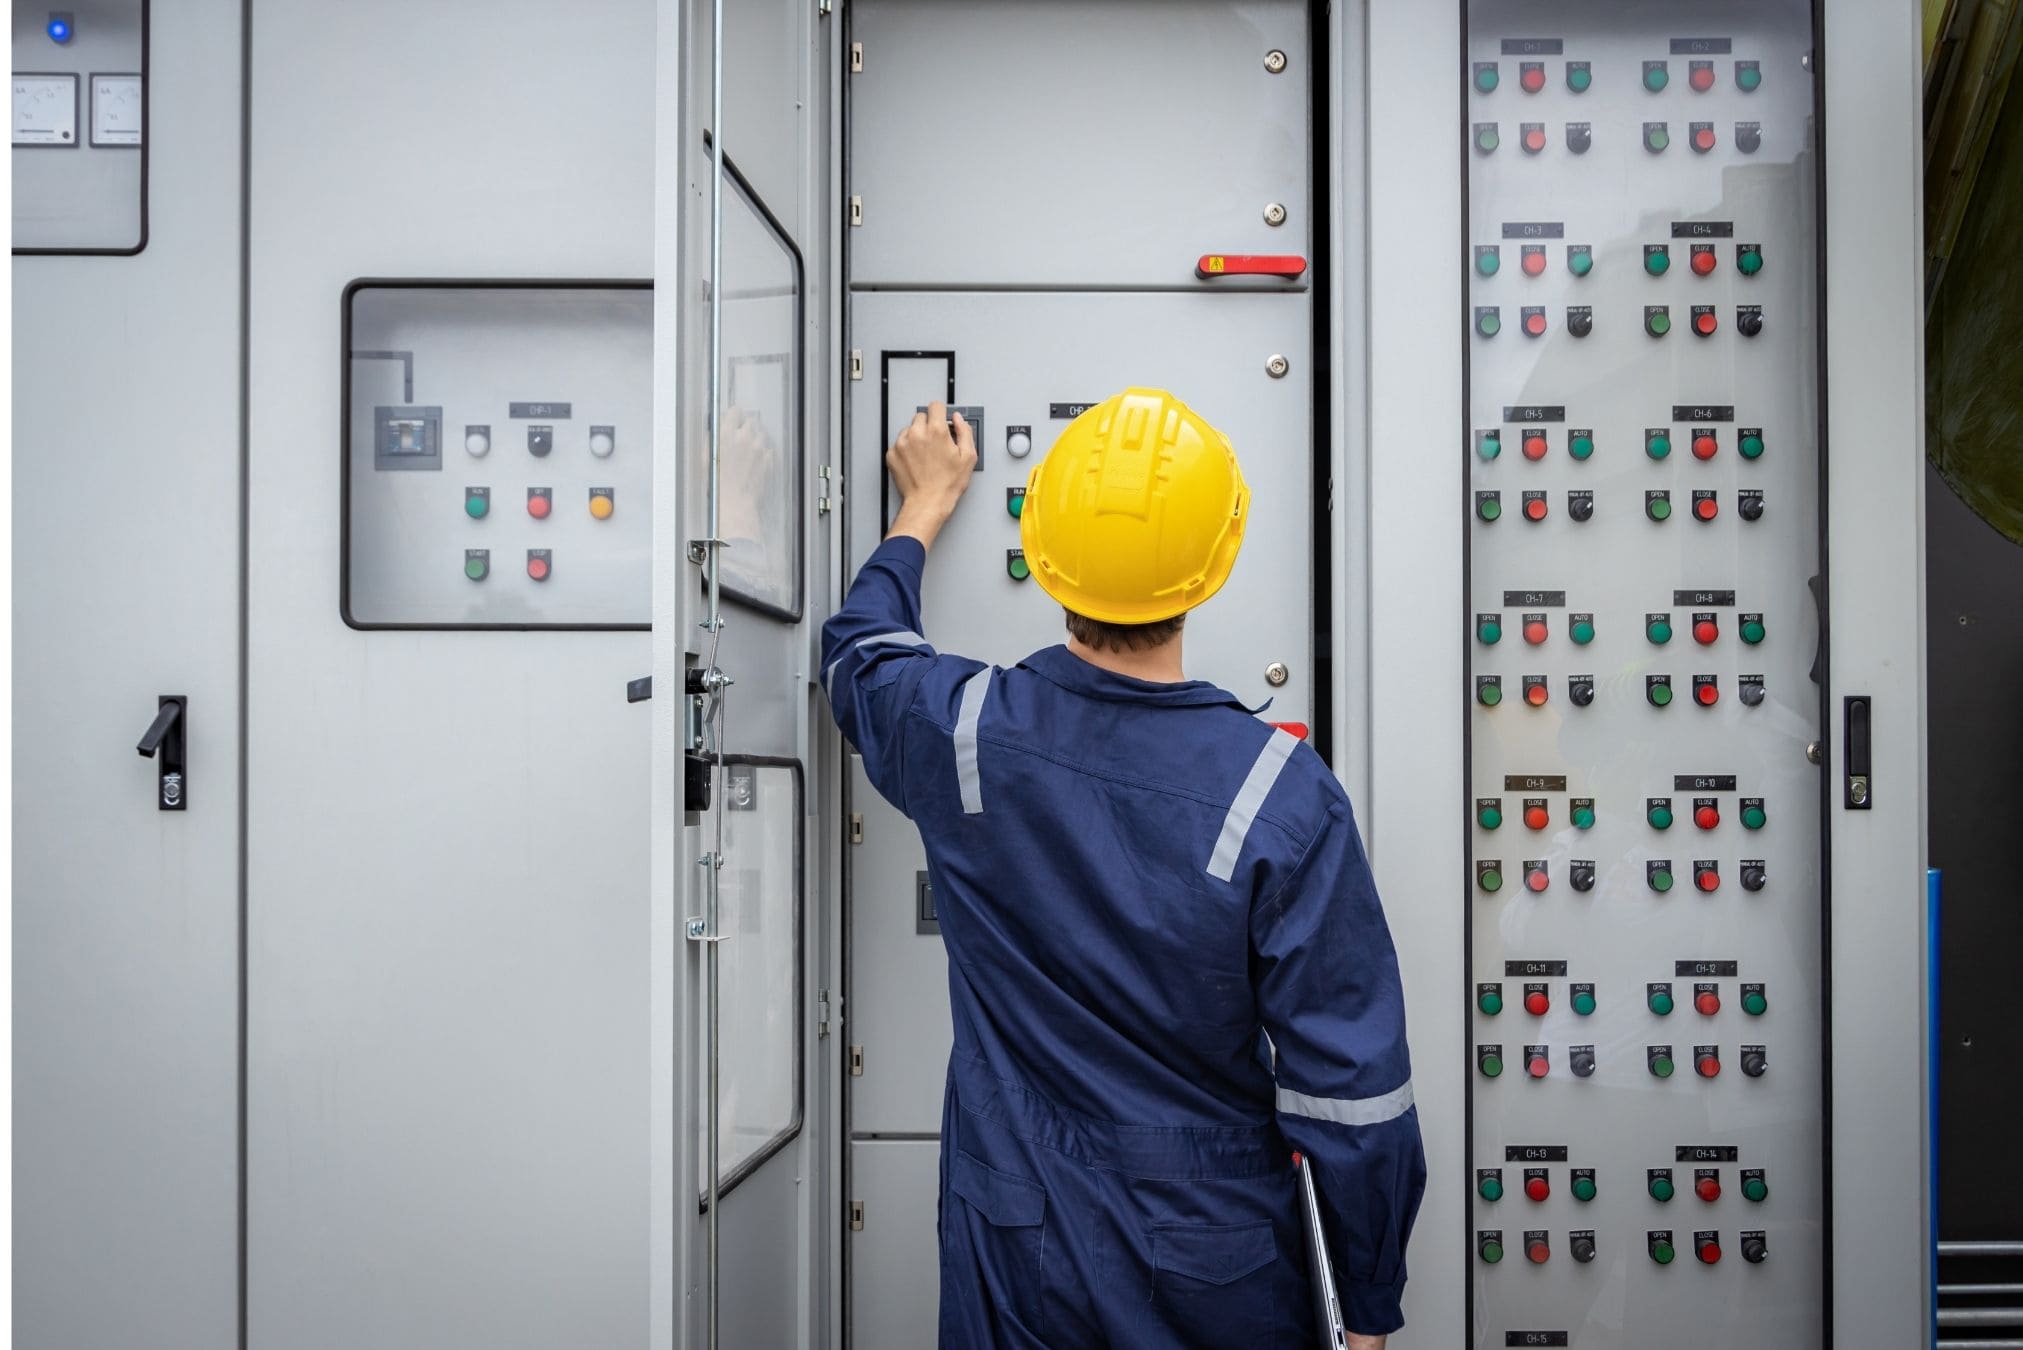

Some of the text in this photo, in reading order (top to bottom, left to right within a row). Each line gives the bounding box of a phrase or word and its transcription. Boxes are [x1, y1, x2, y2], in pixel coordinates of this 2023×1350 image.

[1524, 42, 1541, 52] CH-1
[1691, 41, 1710, 50] CH-2
[1524, 225, 1542, 235] CH-3
[1693, 225, 1711, 234] CH-4
[529, 405, 552, 416] CHP-1
[1525, 409, 1543, 419] CH-5
[1694, 408, 1712, 418] CH-6
[1525, 594, 1544, 603] CH-7
[1695, 593, 1713, 603] CH-8
[1526, 778, 1544, 788] CH-9
[1695, 778, 1715, 788] CH-10
[1527, 963, 1546, 973] CH-11
[1696, 963, 1716, 973] CH-12
[1526, 1148, 1546, 1158] CH-13
[1696, 1149, 1717, 1158] CH-14
[1527, 1334, 1547, 1344] CH-15
